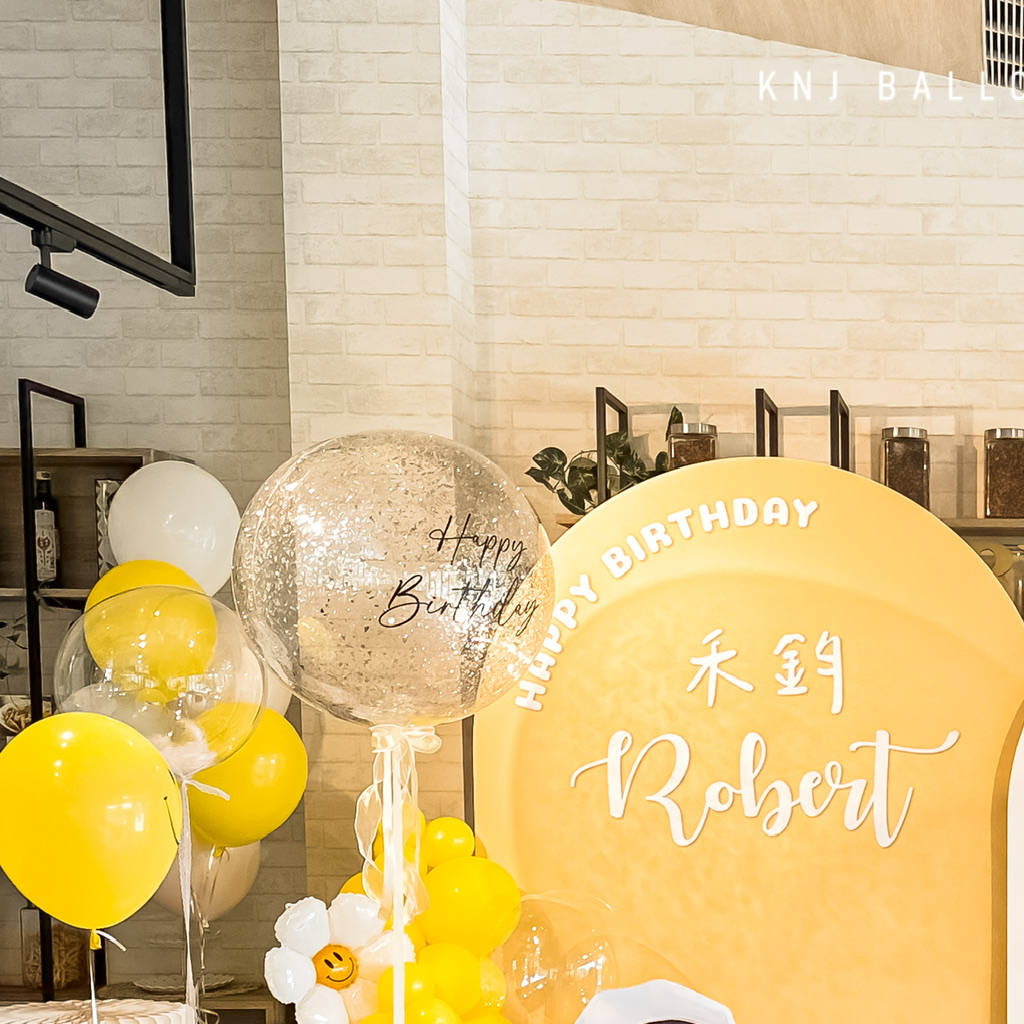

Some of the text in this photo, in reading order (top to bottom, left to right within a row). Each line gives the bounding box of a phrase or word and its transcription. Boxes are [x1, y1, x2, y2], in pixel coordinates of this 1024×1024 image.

[428, 513, 527, 571] Happy
[378, 574, 539, 637] Birthday
[514, 496, 819, 712] HAPPY BIRTHDAY
[570, 729, 961, 848] Robert
